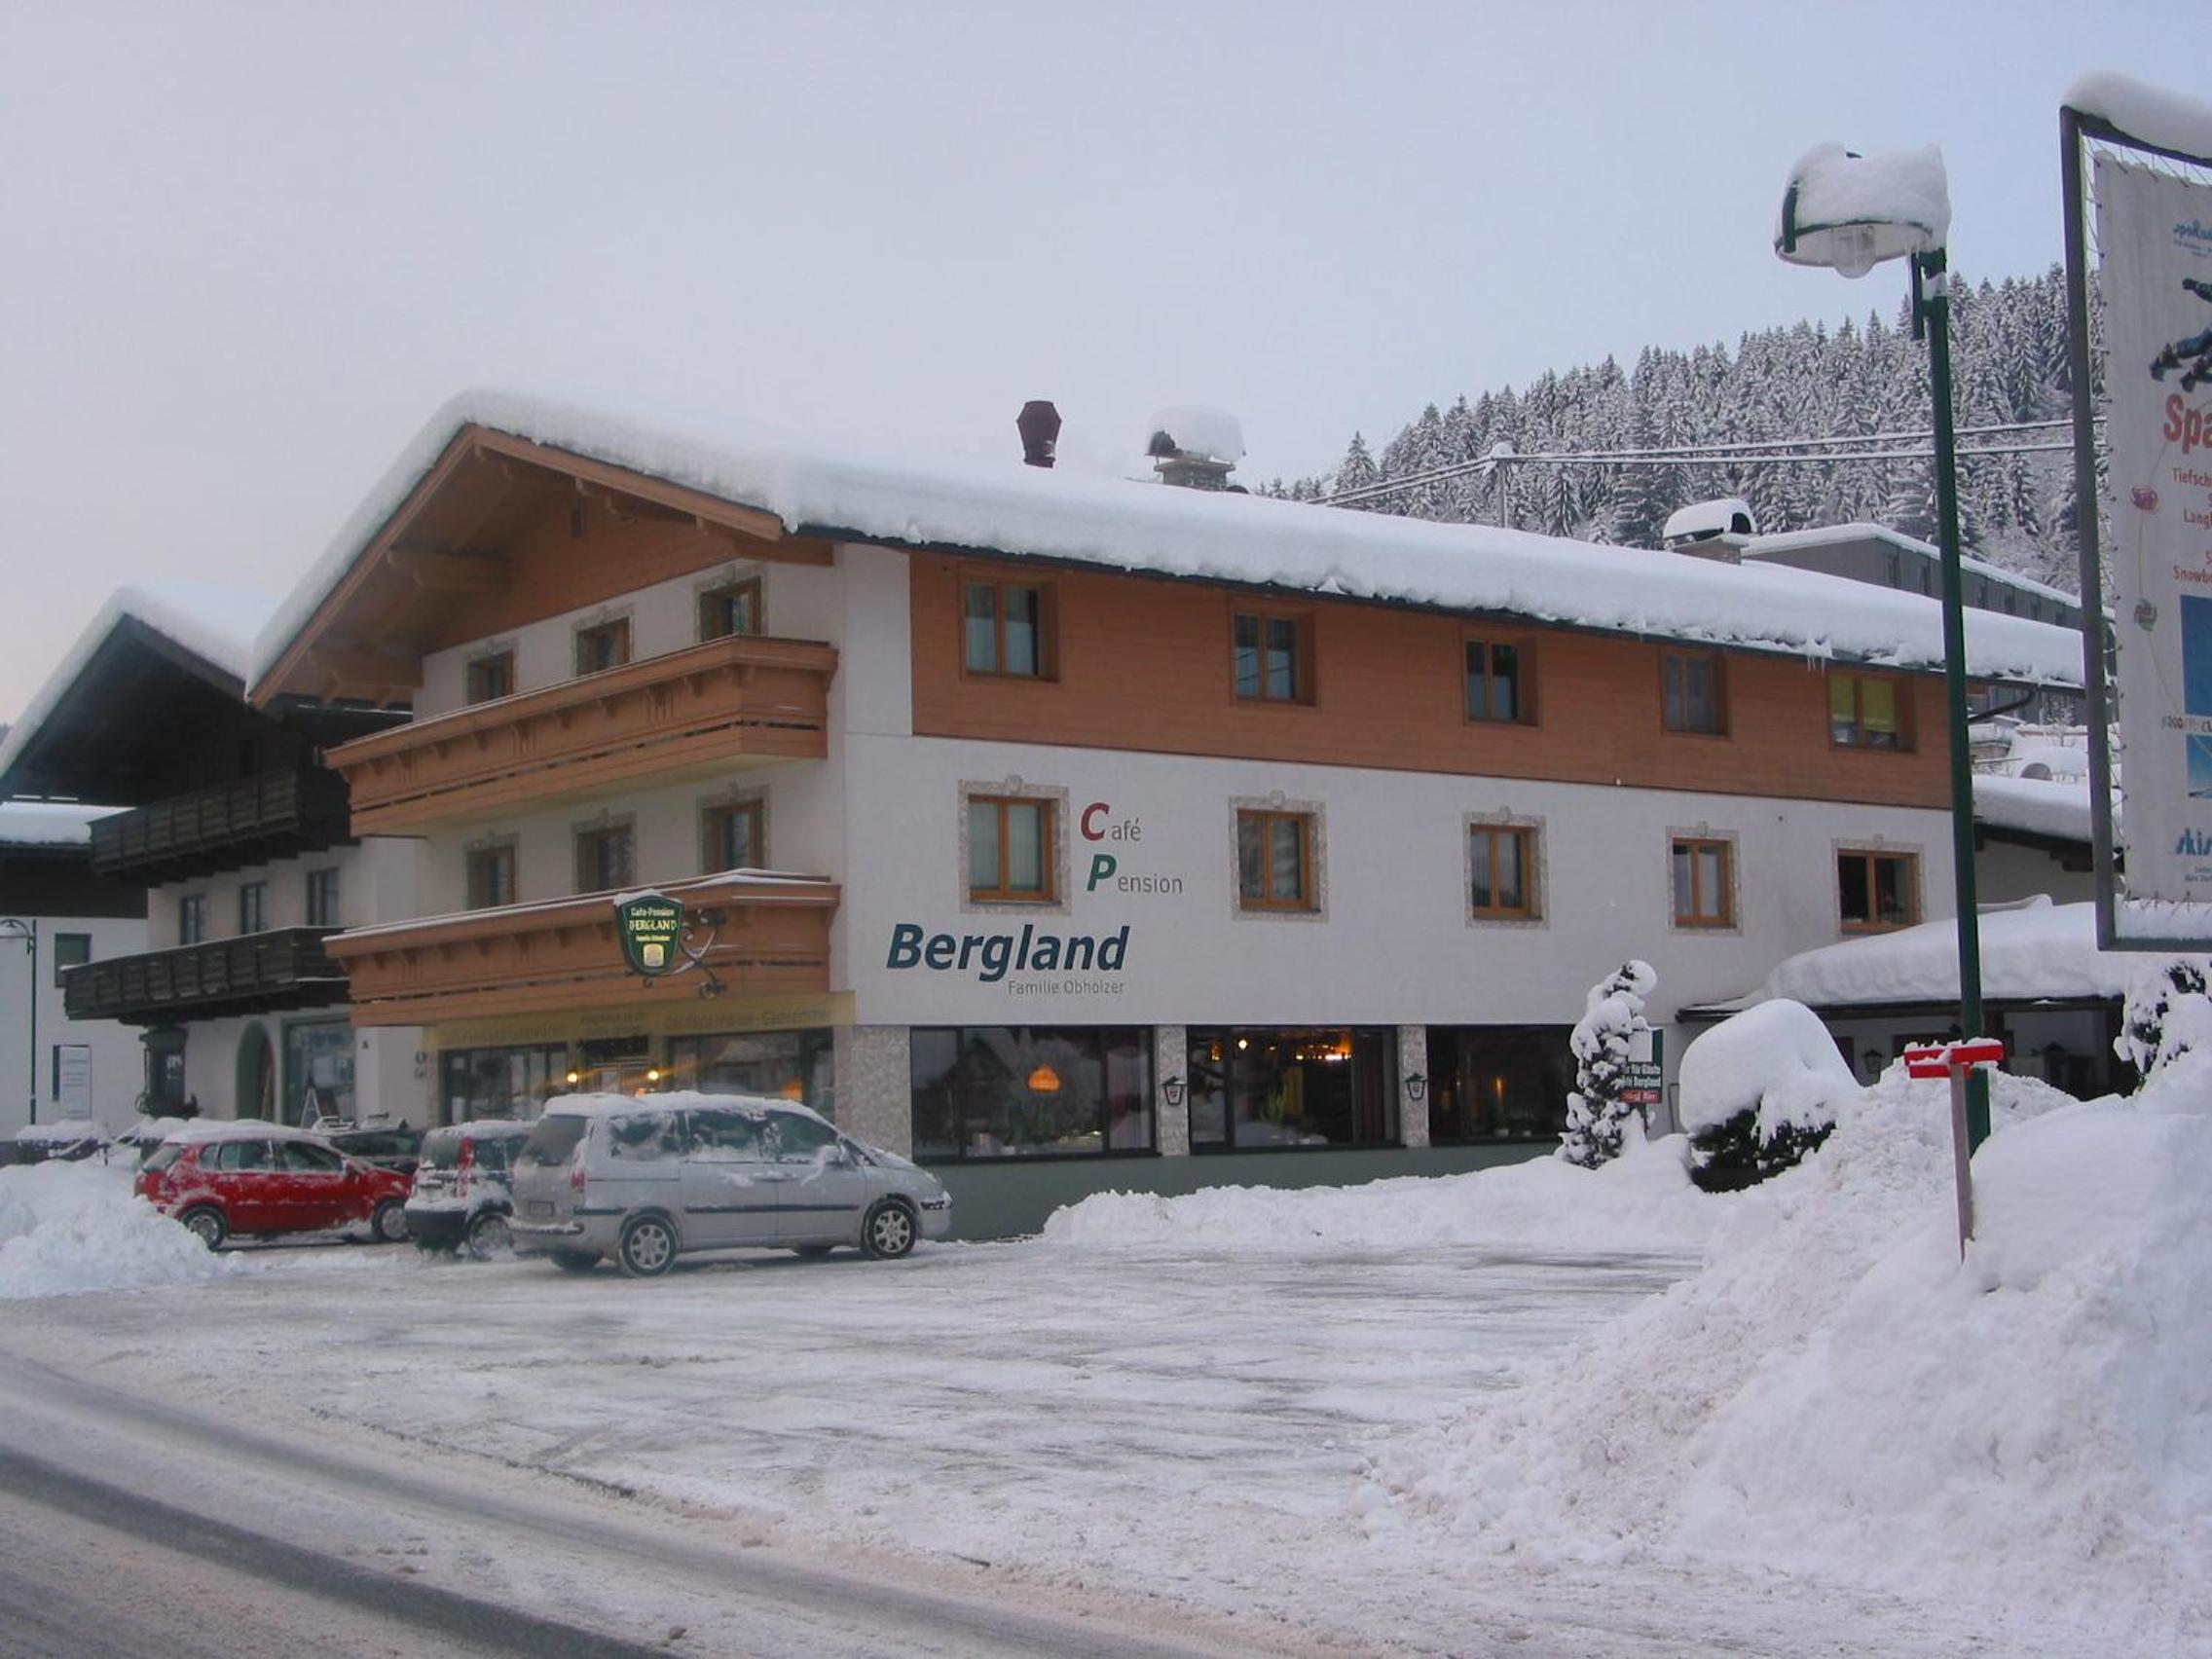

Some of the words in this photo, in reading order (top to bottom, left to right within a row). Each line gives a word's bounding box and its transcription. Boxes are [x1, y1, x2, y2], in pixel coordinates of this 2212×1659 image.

[1080, 801, 1141, 841] Café
[1087, 853, 1183, 894] Pension
[886, 923, 1130, 982] Bergland
[1008, 979, 1059, 994] Familie
[1063, 979, 1124, 995] Obholzer
